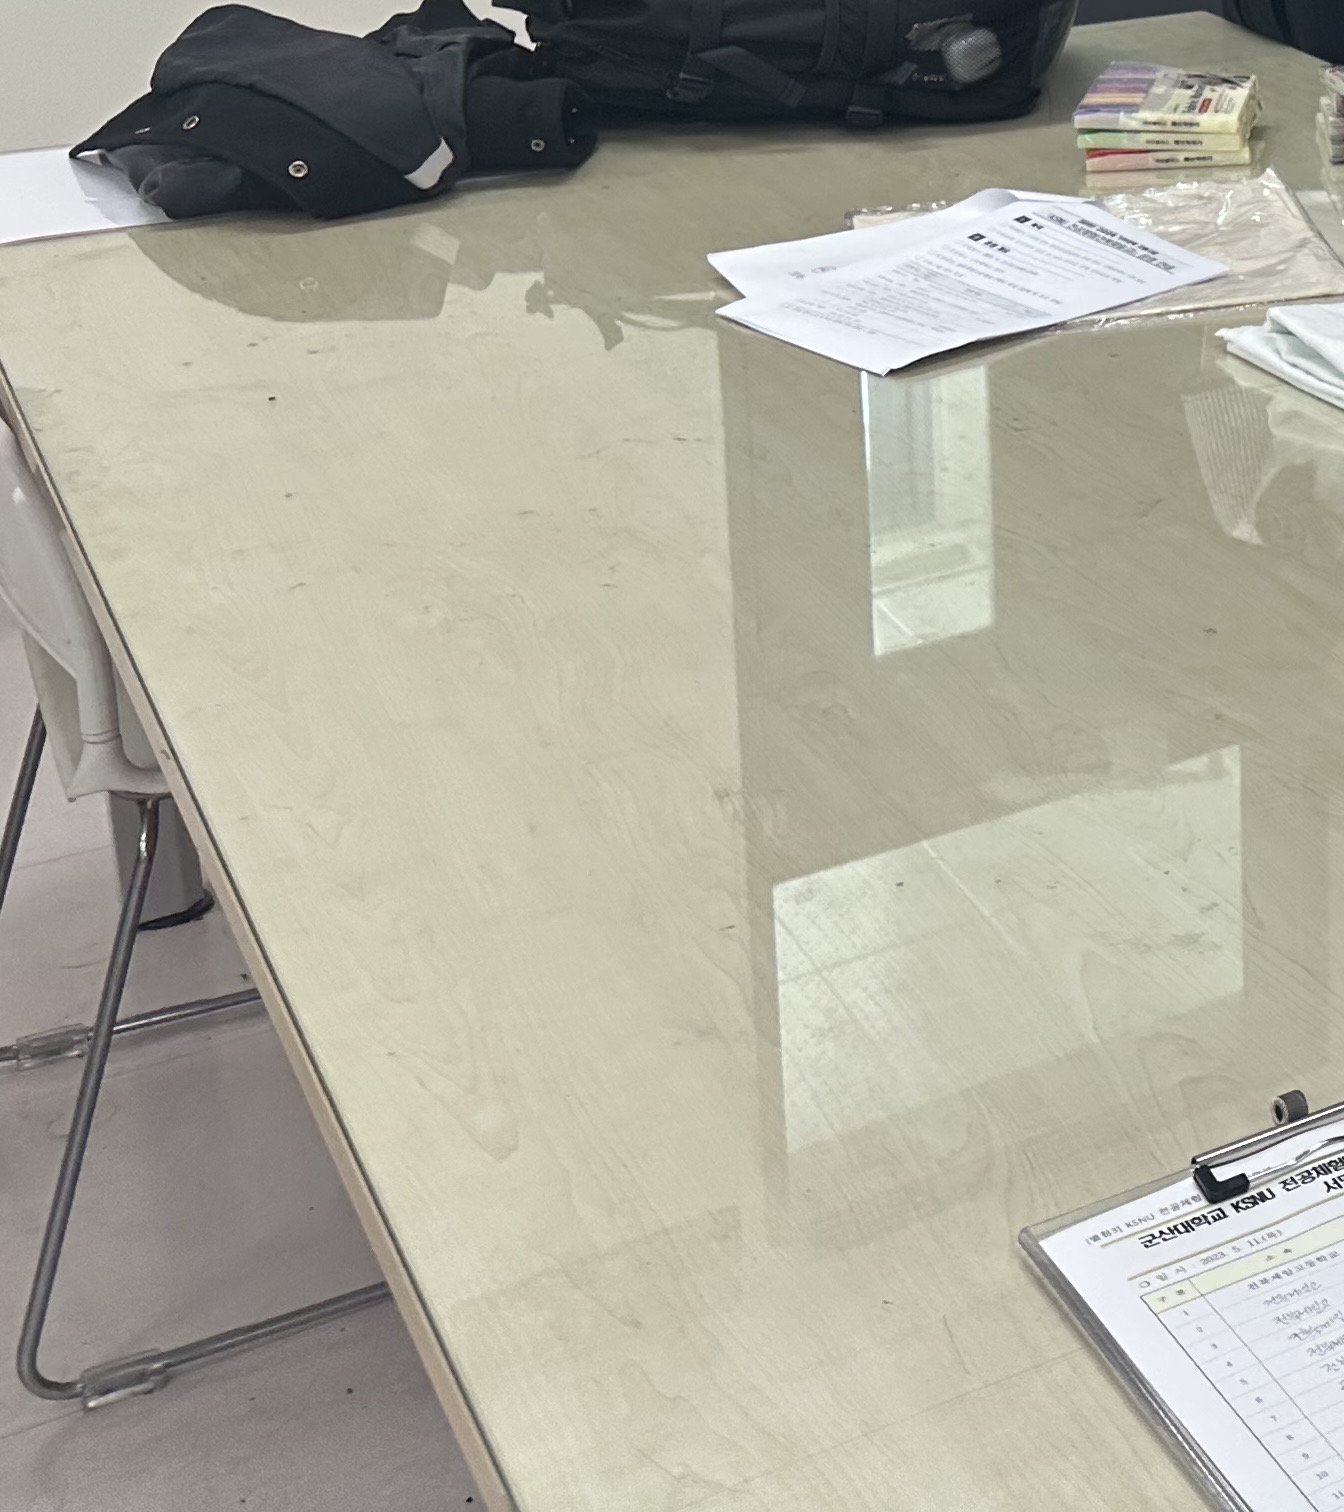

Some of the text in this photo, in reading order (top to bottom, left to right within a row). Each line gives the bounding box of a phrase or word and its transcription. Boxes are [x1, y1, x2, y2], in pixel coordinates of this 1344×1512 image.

[1124, 1213, 1156, 1229] KSNU
[1138, 1208, 1228, 1248] 군산대학교
[1231, 1188, 1275, 1213] KSNU
